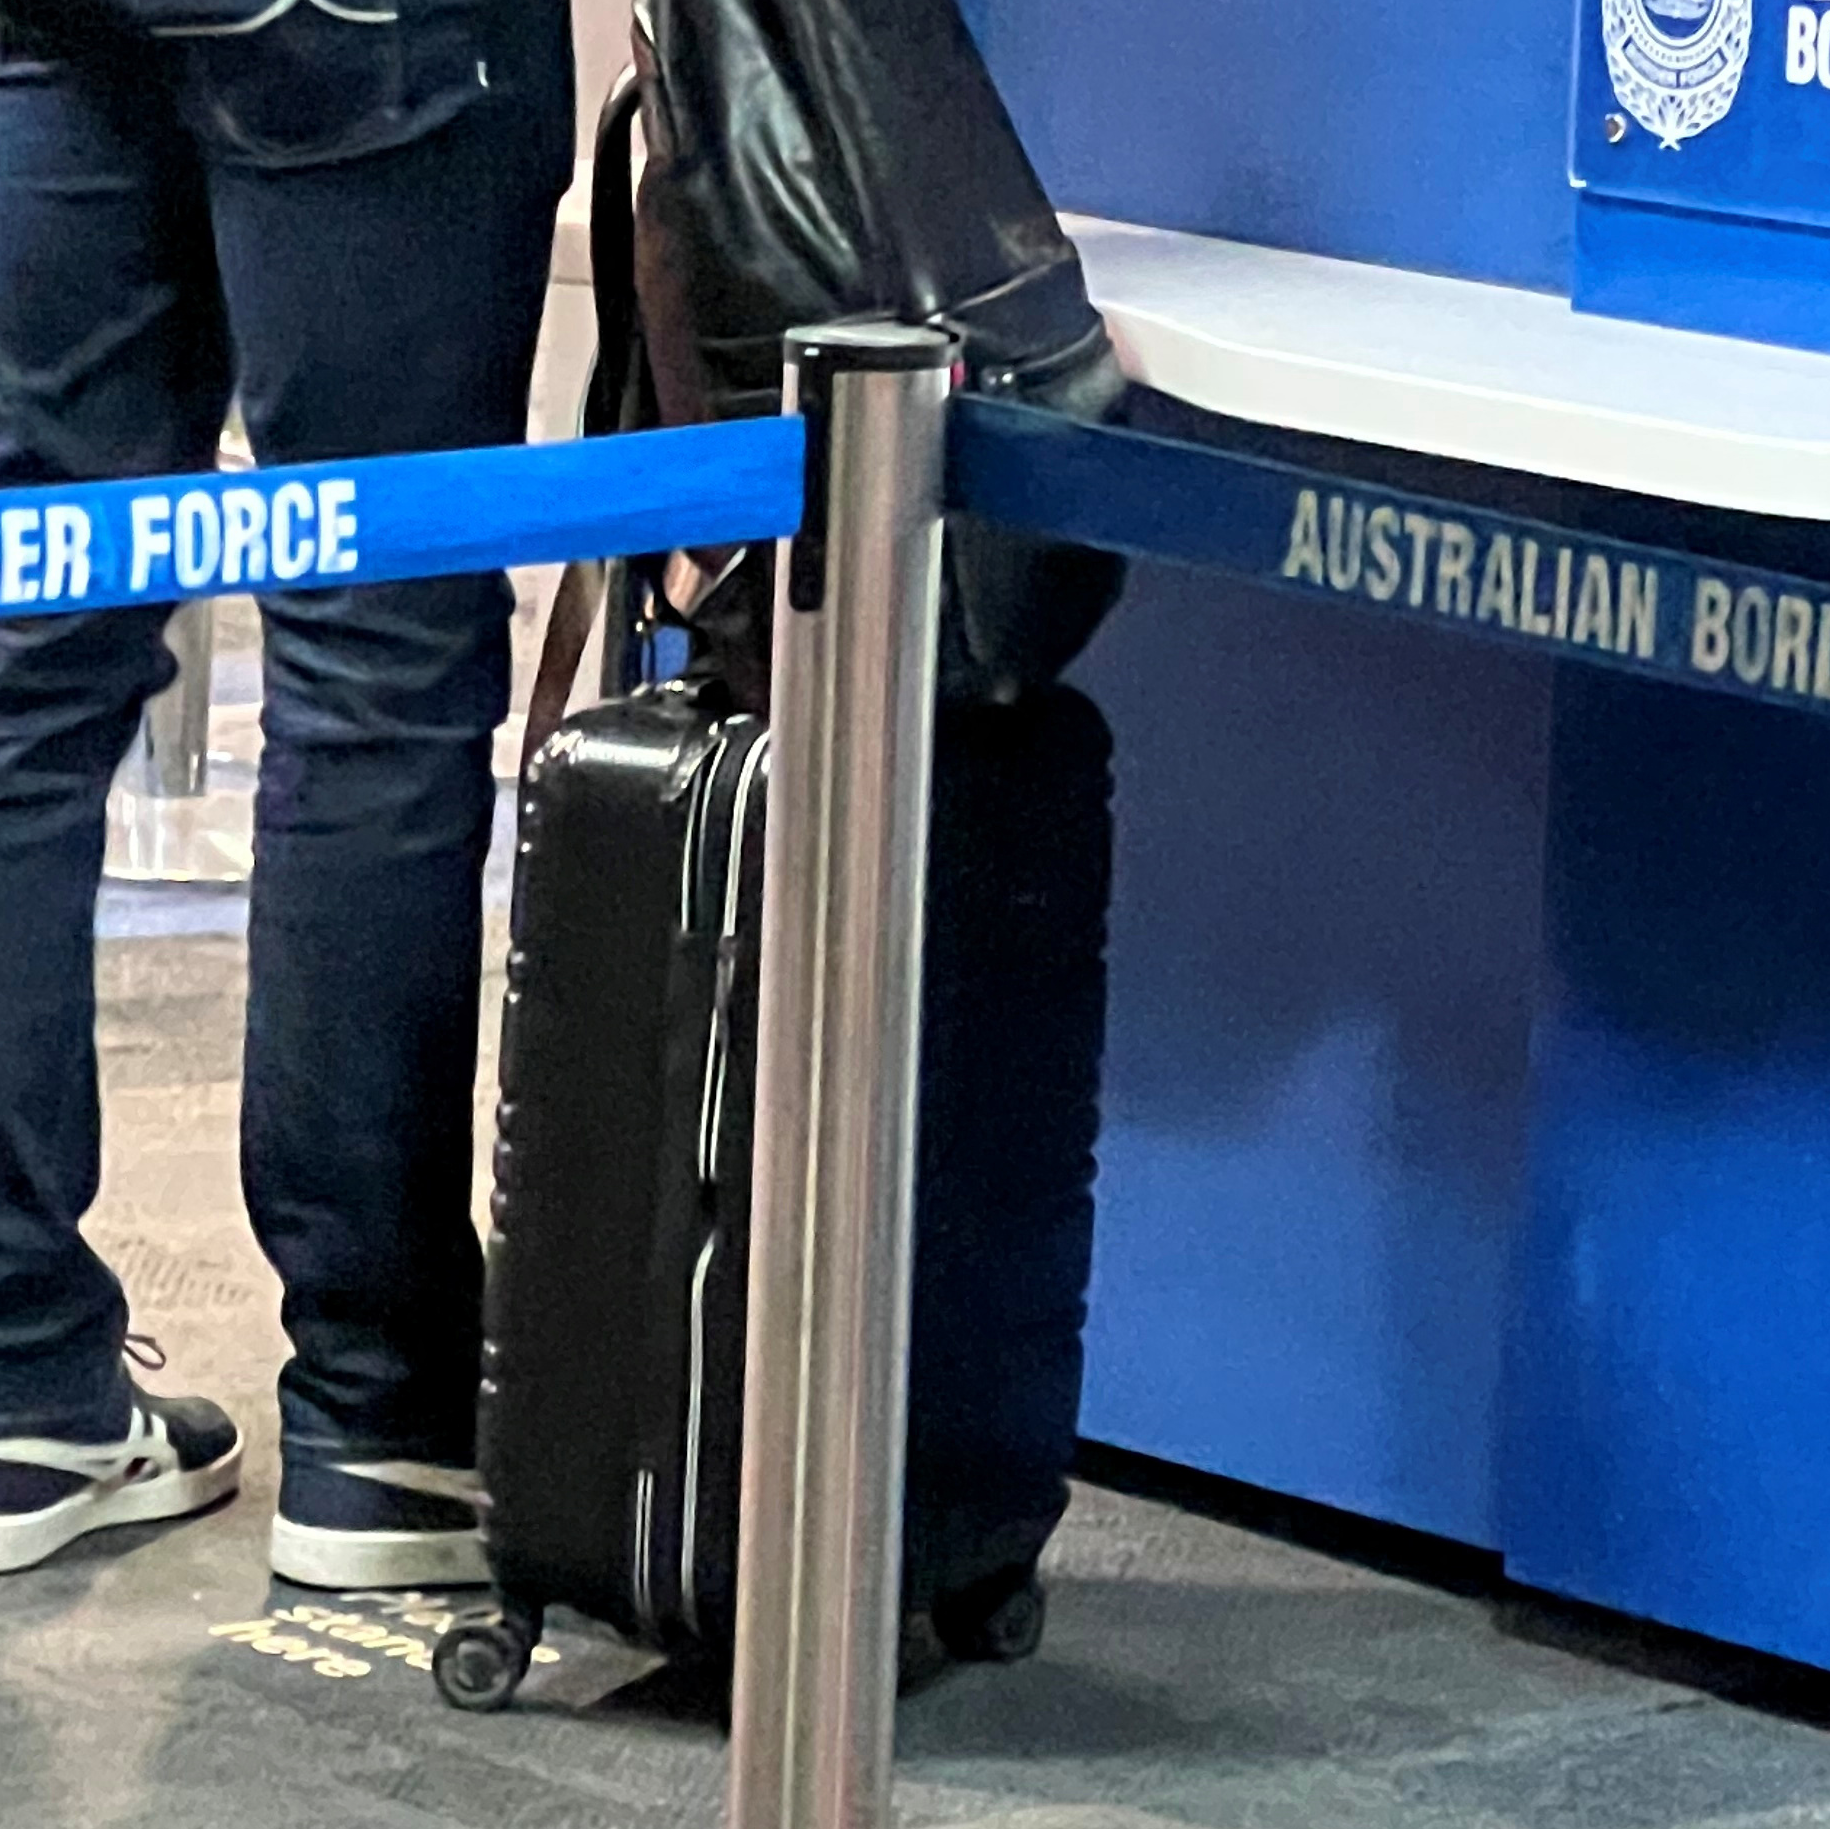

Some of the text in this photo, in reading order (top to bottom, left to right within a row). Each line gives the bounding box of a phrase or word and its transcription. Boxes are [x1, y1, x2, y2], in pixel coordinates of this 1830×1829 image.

[129, 479, 359, 594] FORCE
[1282, 490, 1658, 660] AUSTRALIAN
[273, 1604, 434, 1671] stan
